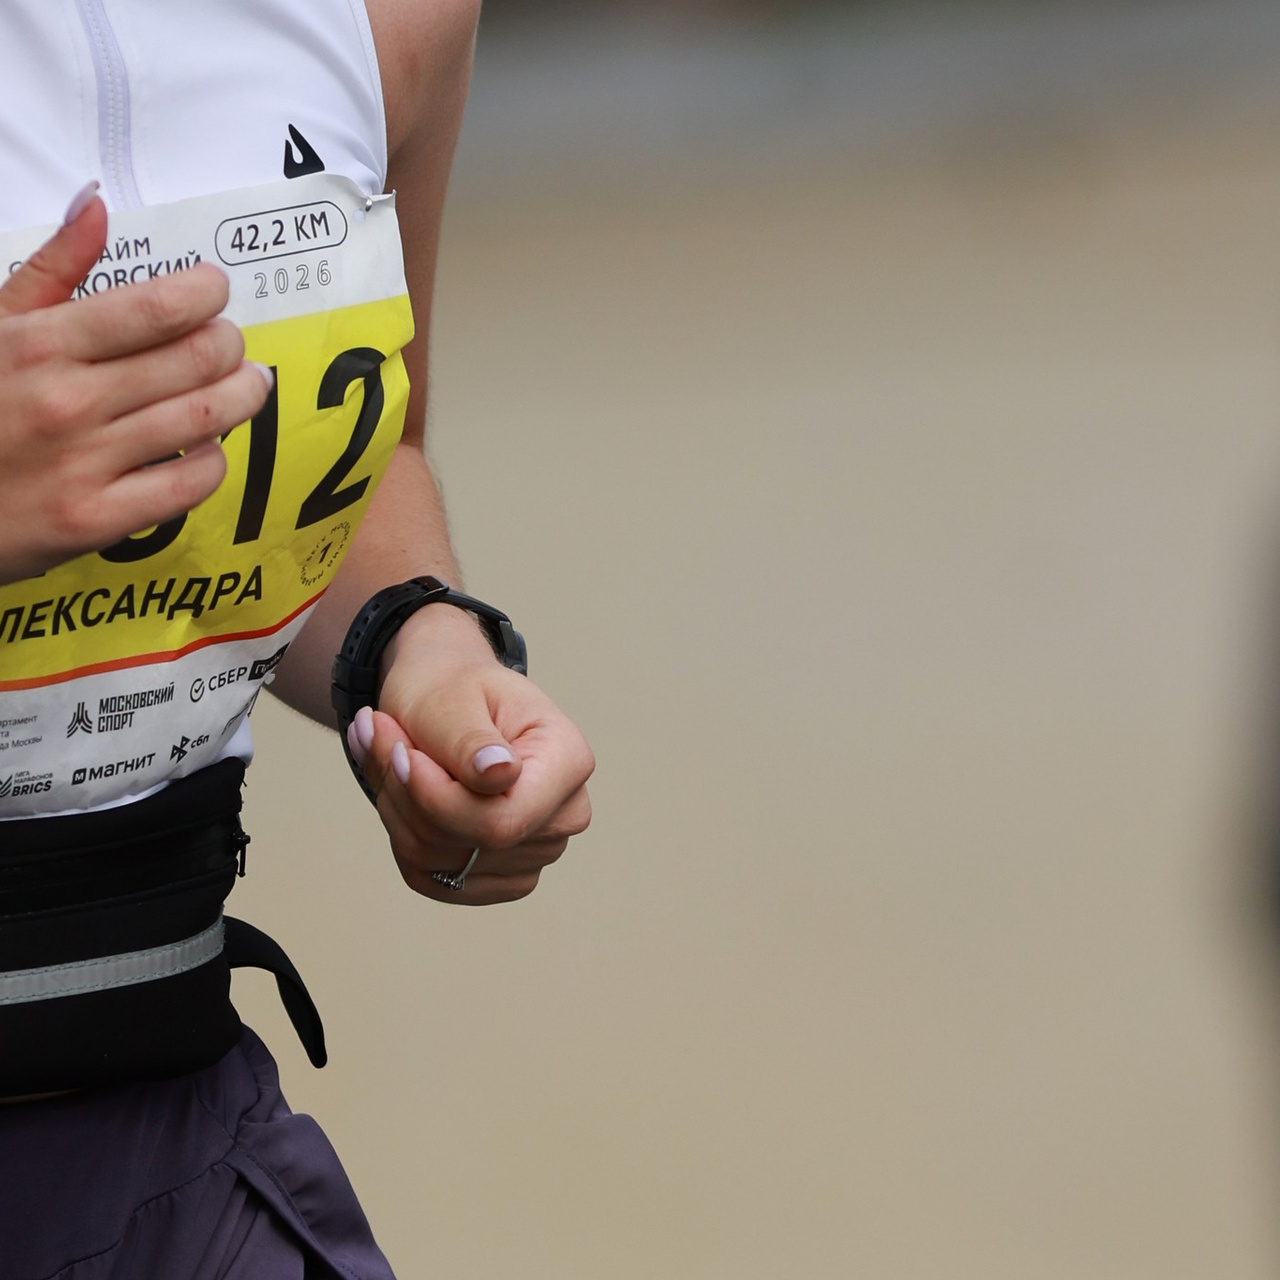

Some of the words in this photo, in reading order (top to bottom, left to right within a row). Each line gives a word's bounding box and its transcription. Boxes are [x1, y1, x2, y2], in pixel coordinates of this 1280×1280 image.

[230, 218, 287, 254] 42,2
[294, 210, 331, 242] КМ
[253, 259, 332, 299] 2026
[208, 666, 248, 692] СБЕР
[98, 681, 175, 715] МОСКОВСКИЙ
[97, 711, 135, 734] СПОРТ
[11, 735, 43, 748] Москвы
[11, 779, 53, 798] BRICS
